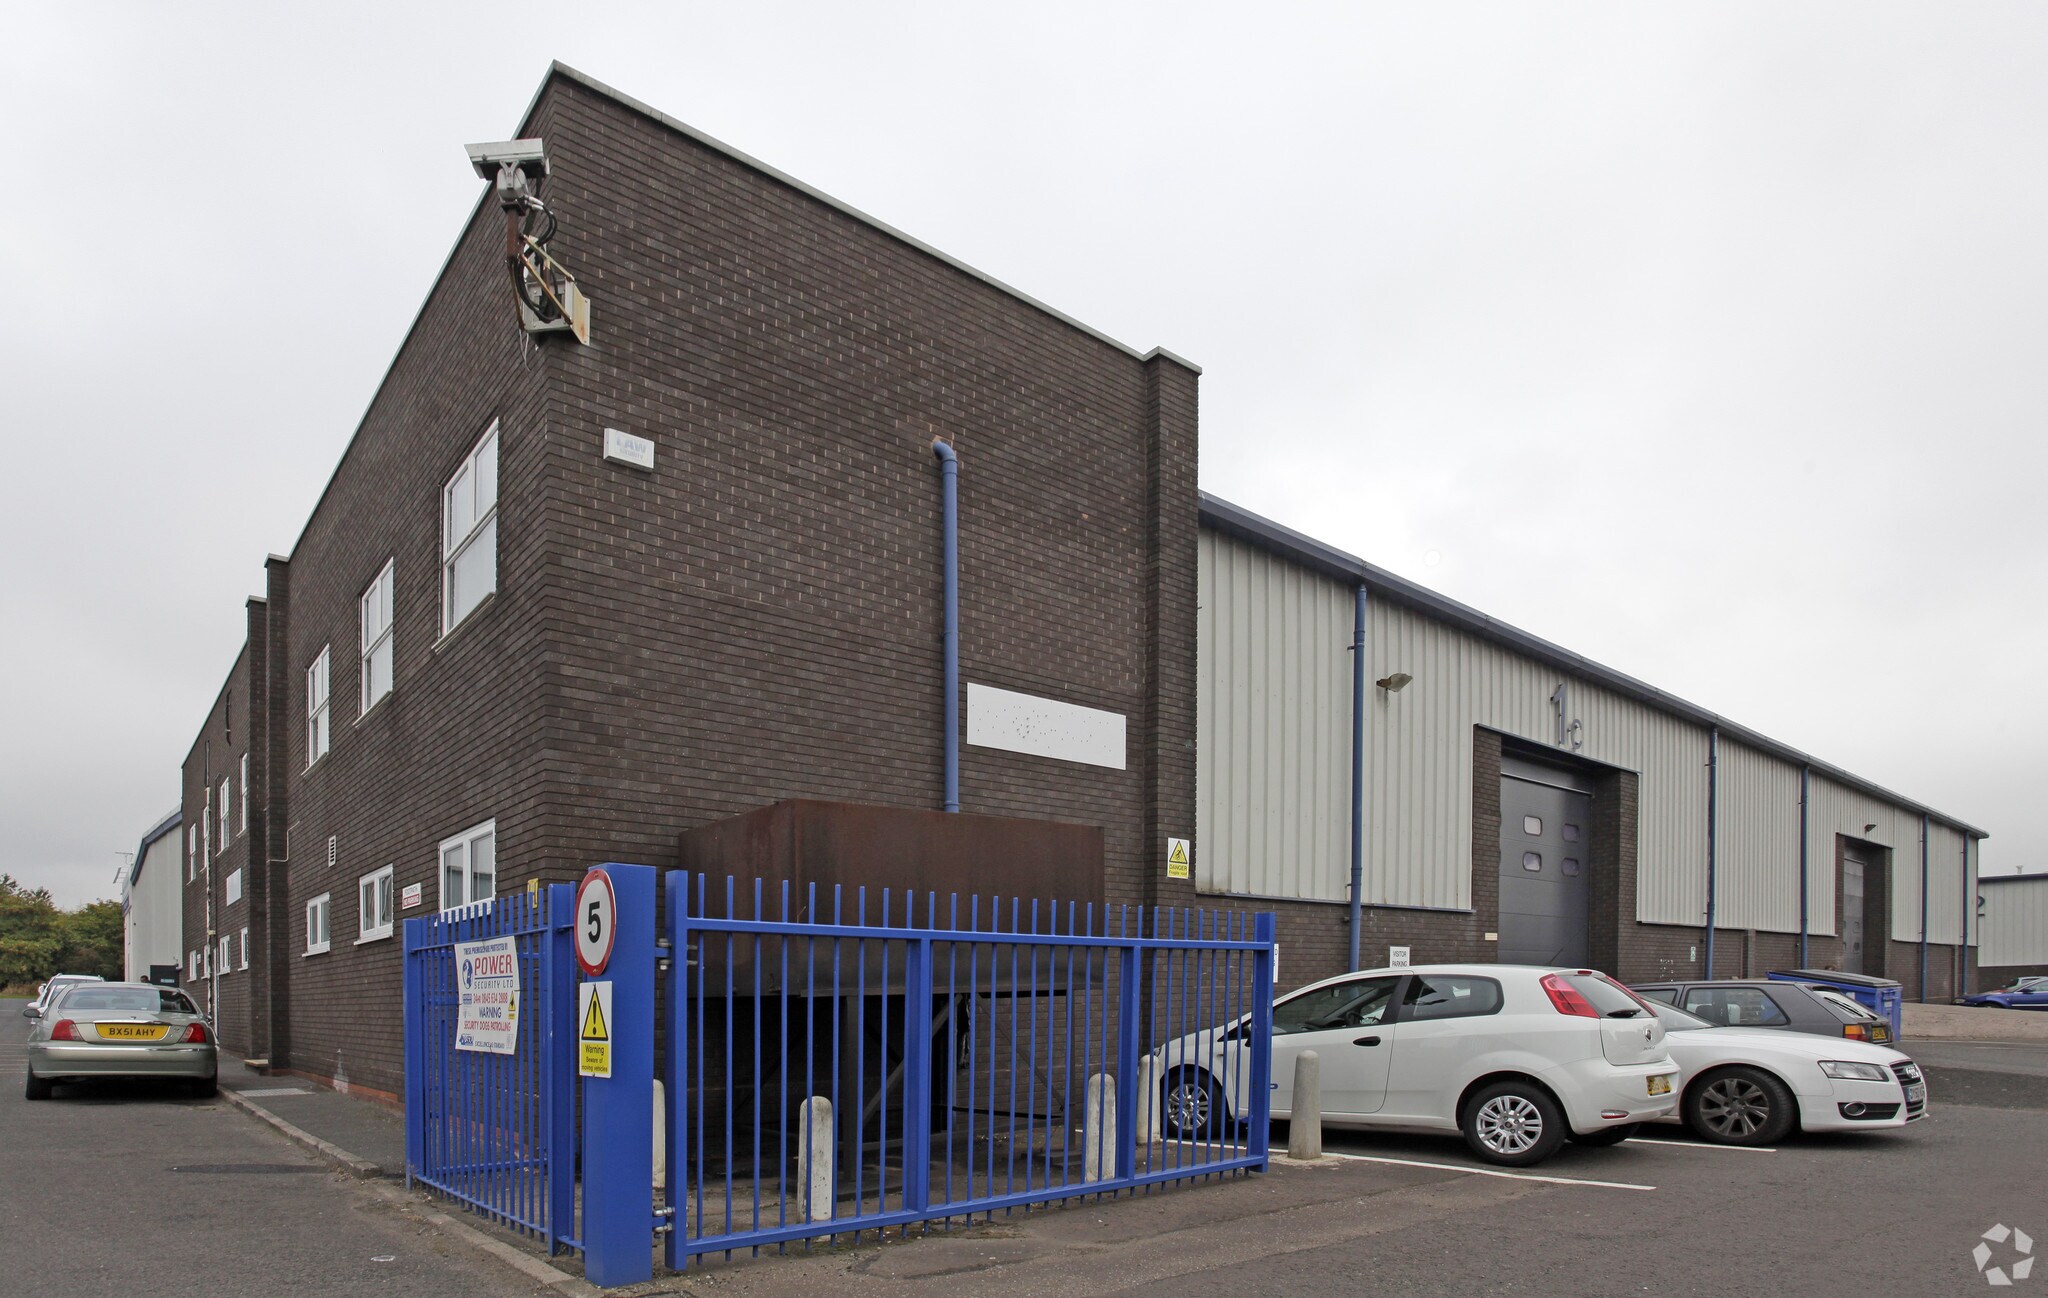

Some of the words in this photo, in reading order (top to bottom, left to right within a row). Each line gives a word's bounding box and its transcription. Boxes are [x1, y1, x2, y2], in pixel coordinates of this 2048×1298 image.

[588, 901, 601, 944] 5
[474, 954, 513, 975] POWER
[474, 980, 500, 989] SECURITY
[502, 979, 513, 988] LTD
[479, 1006, 502, 1018] WARNING
[109, 1027, 133, 1036] BX51
[135, 1027, 156, 1036] AHY
[585, 1044, 605, 1057] Warning
